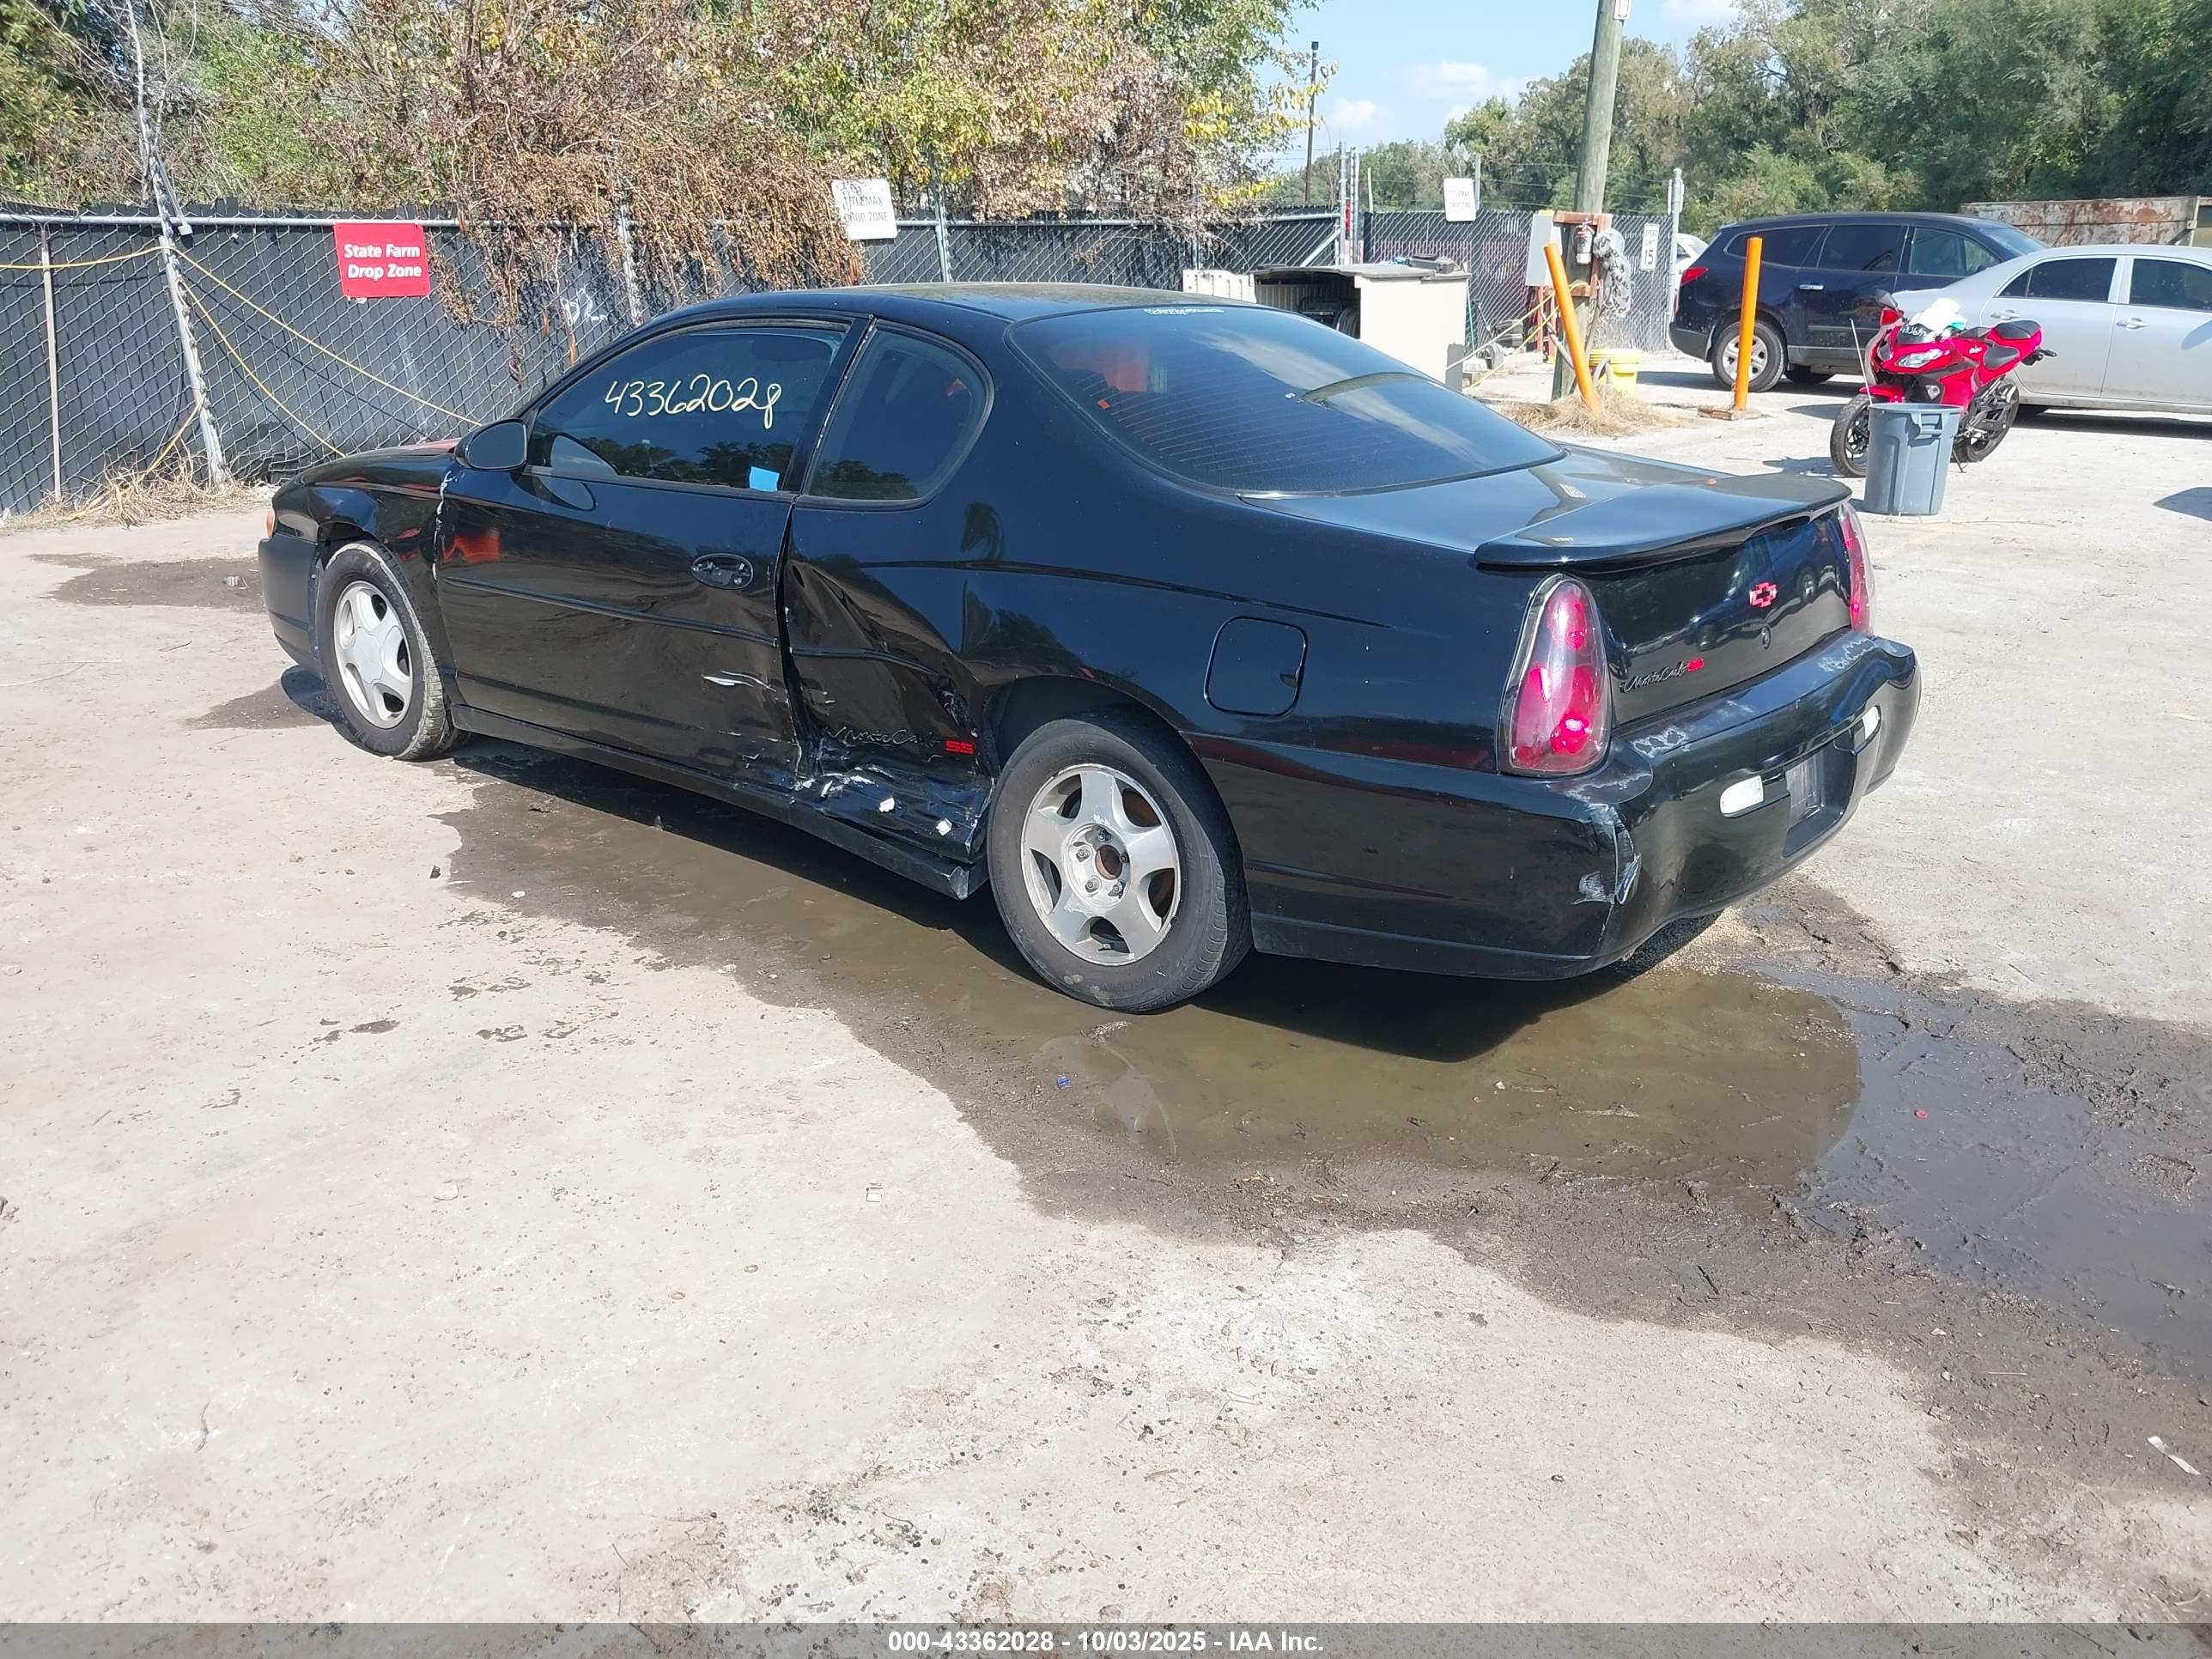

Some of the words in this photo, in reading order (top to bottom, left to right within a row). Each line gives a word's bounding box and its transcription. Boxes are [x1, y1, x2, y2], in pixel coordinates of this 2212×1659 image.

[868, 211, 889, 222] ZONE
[344, 243, 382, 258] State
[386, 243, 420, 258] Farm
[1644, 249, 1654, 265] 15
[348, 264, 384, 282] Drop
[387, 264, 422, 278] Zone
[605, 374, 782, 429] 43362028
